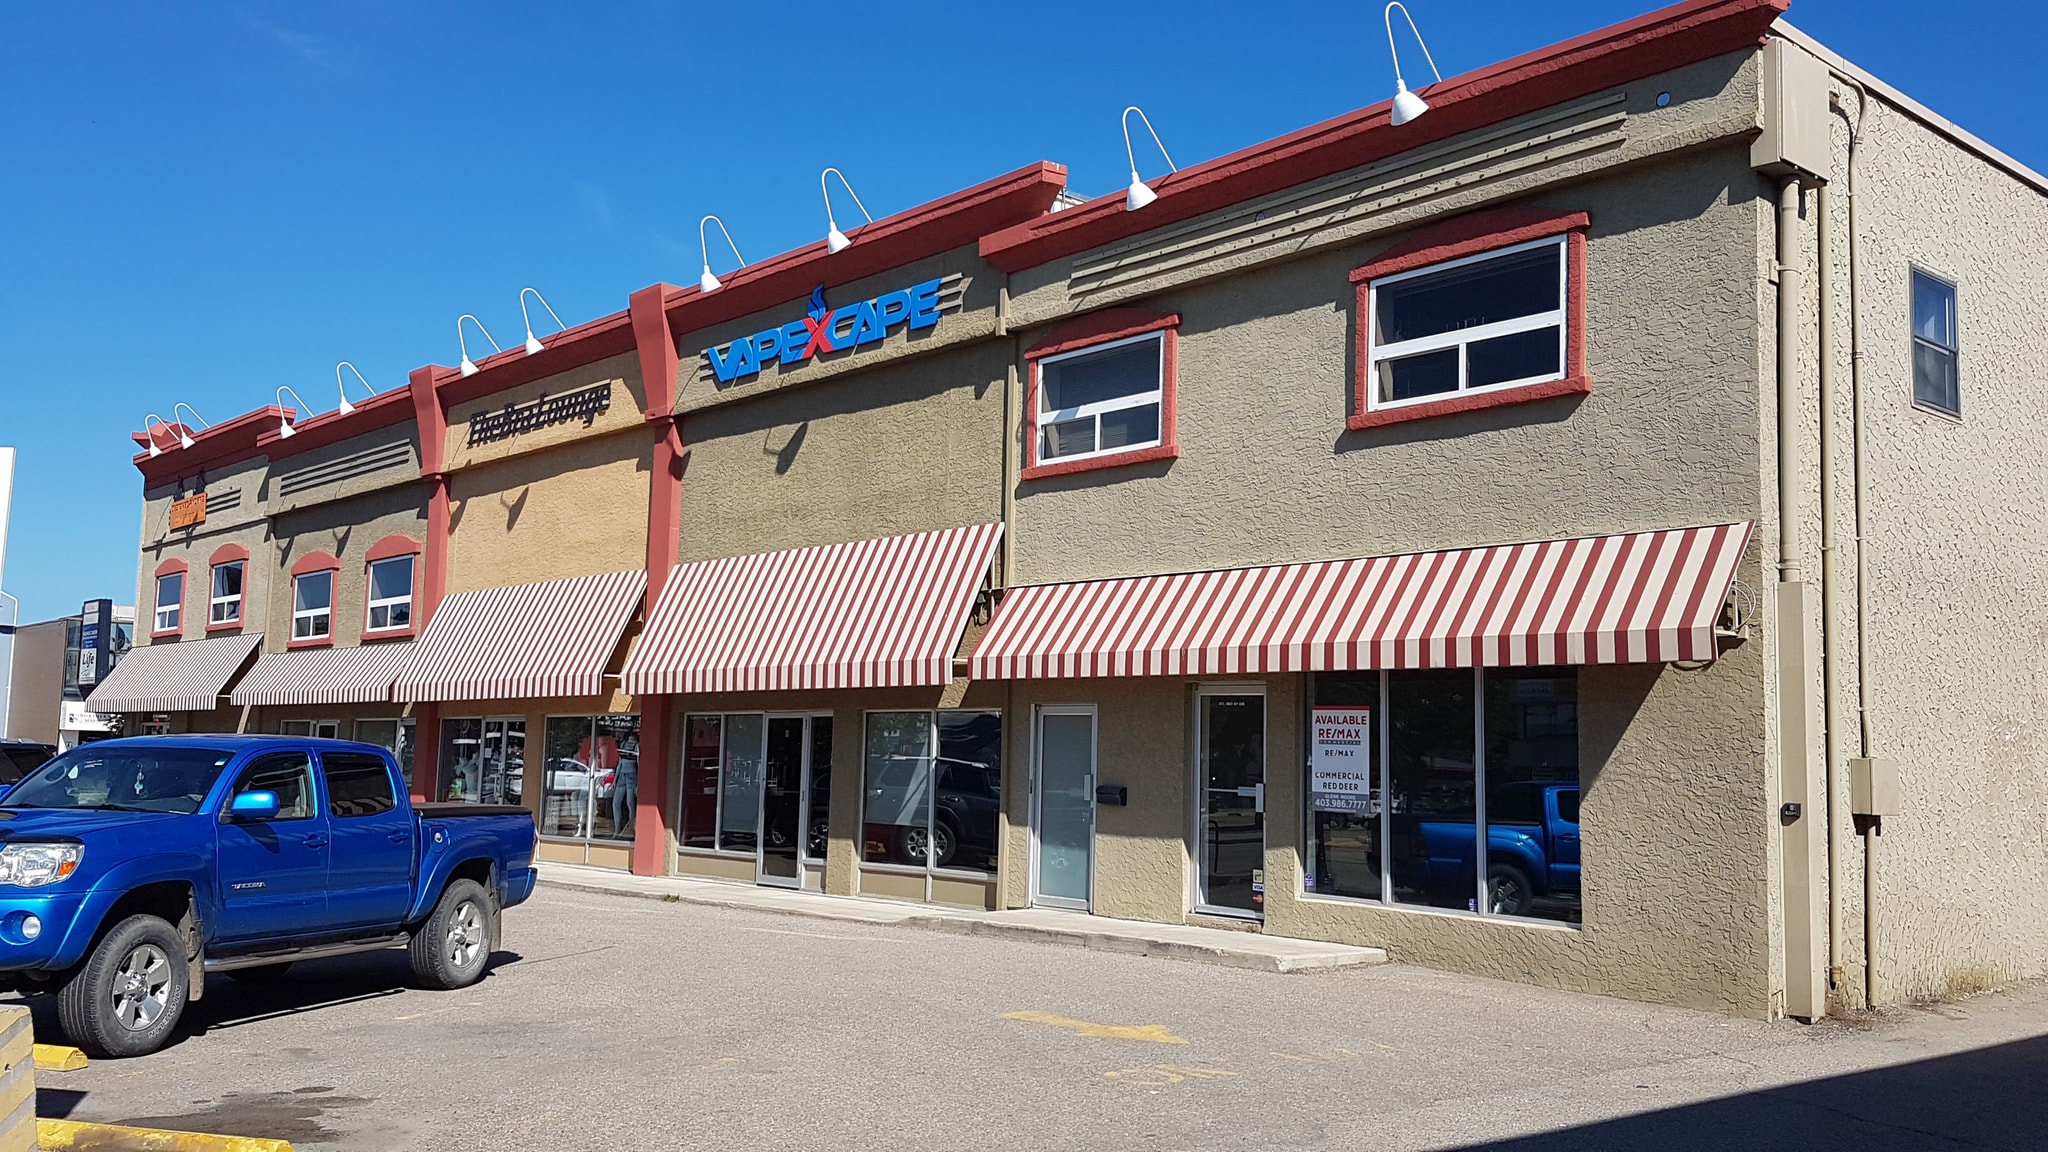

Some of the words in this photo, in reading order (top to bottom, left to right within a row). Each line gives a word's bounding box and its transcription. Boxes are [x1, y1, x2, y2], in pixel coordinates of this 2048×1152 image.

[707, 277, 942, 382] VAPEXCAPE
[82, 651, 95, 668] Life
[1314, 715, 1367, 725] AVAILABLE
[1318, 728, 1361, 739] RE/MAX
[1324, 749, 1355, 757] RE/MAX
[1314, 771, 1365, 781] COMMERCIAL
[1322, 781, 1338, 790] RED
[1338, 782, 1359, 791] DEER
[1314, 798, 1367, 810] 403.986.7777
[147, 984, 182, 1039] MICHELIN
